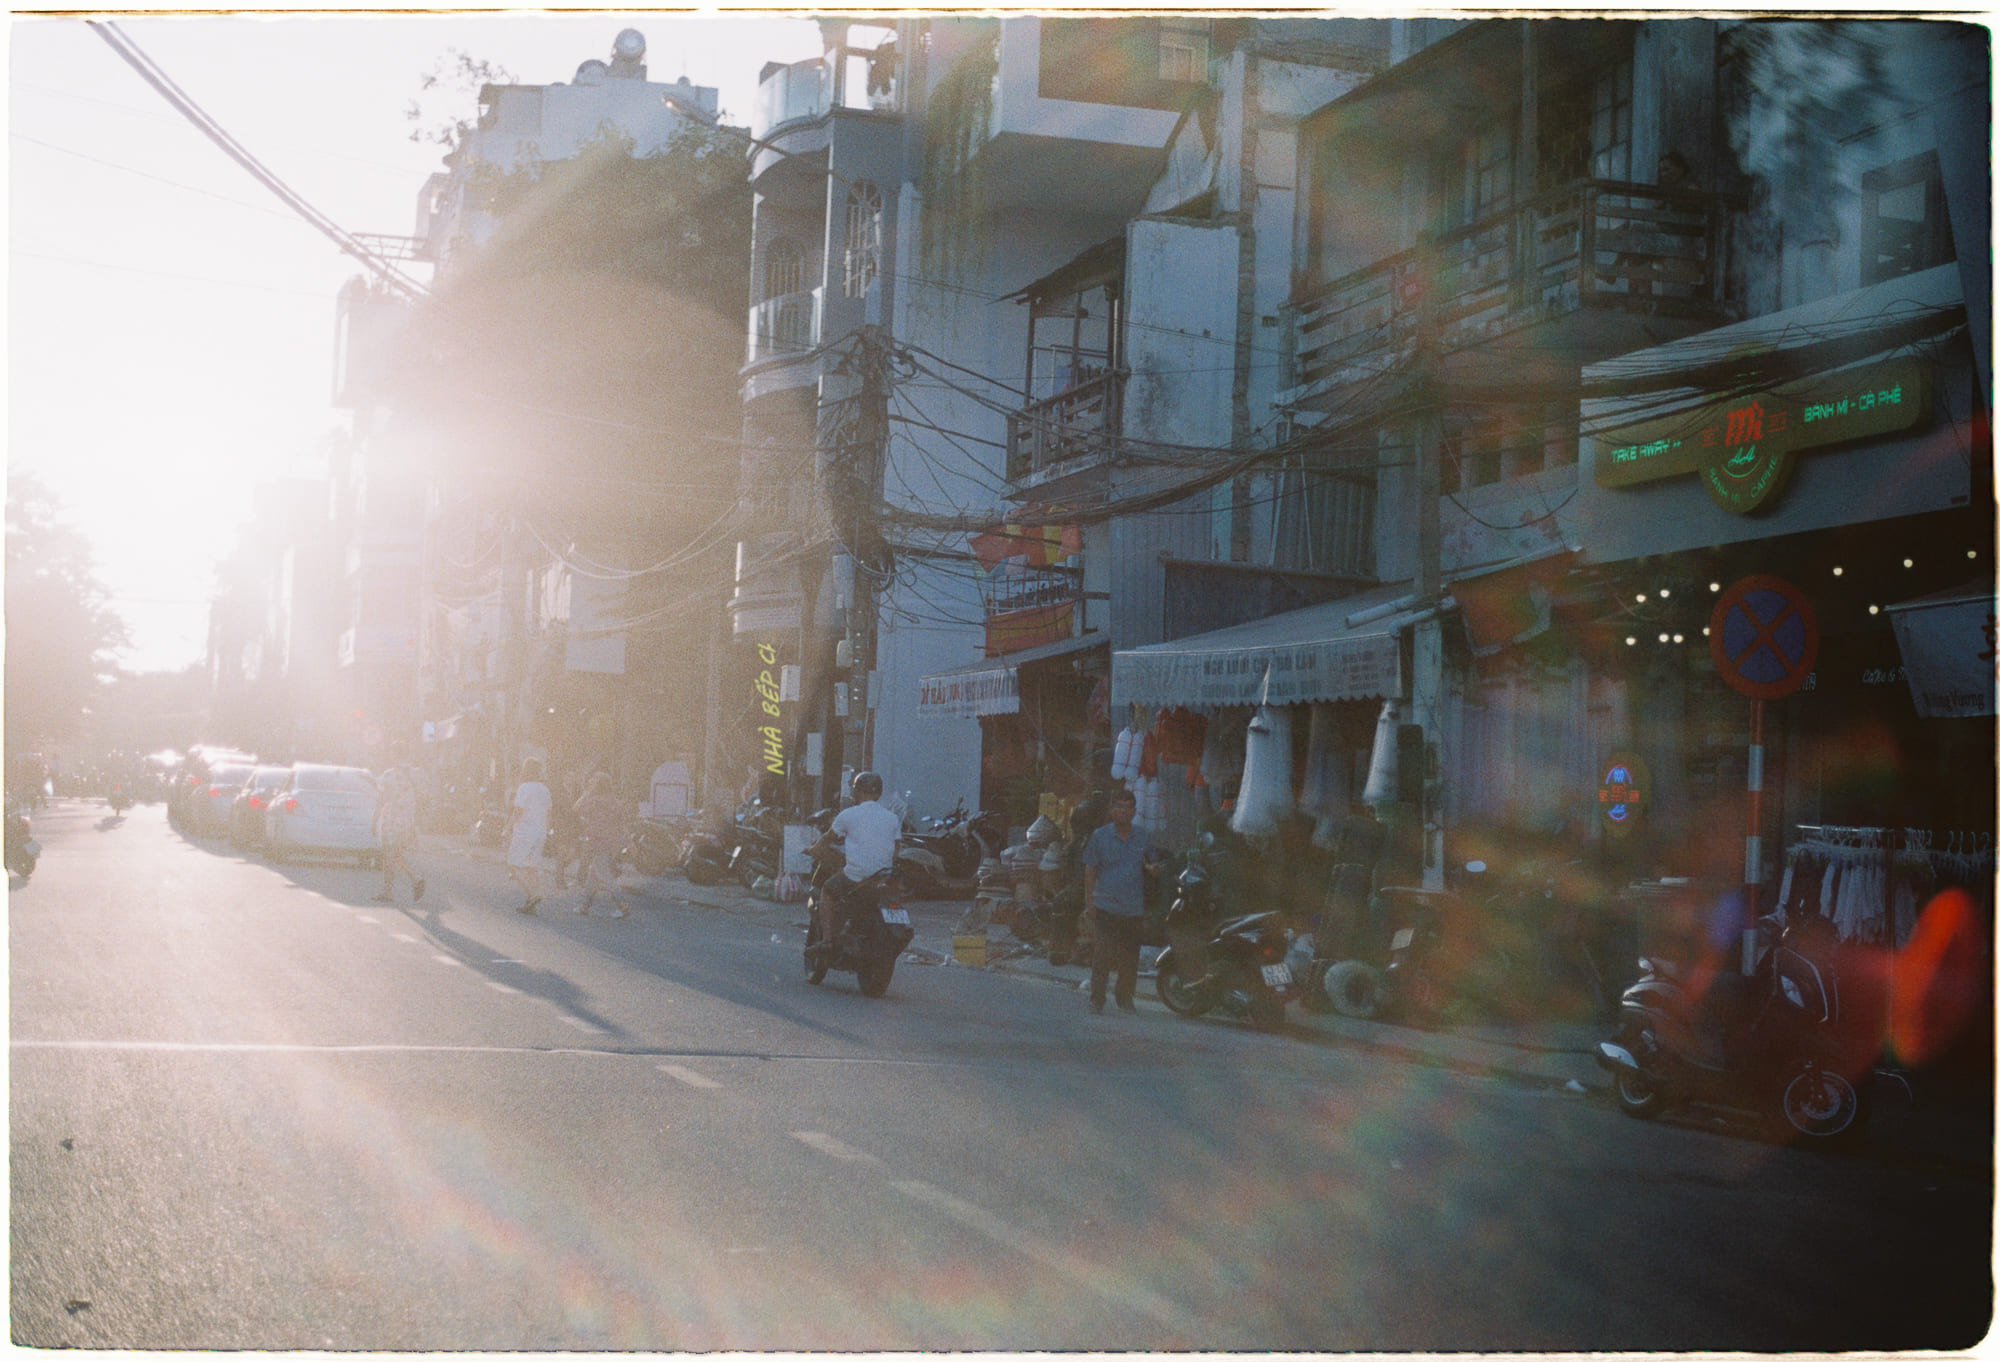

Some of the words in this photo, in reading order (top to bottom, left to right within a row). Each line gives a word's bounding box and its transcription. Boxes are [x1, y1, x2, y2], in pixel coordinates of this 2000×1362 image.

[1611, 444, 1638, 464] TAKE
[1639, 438, 1672, 460] AWAY
[754, 669, 782, 718] BẾP
[757, 726, 786, 777] NHÀ
